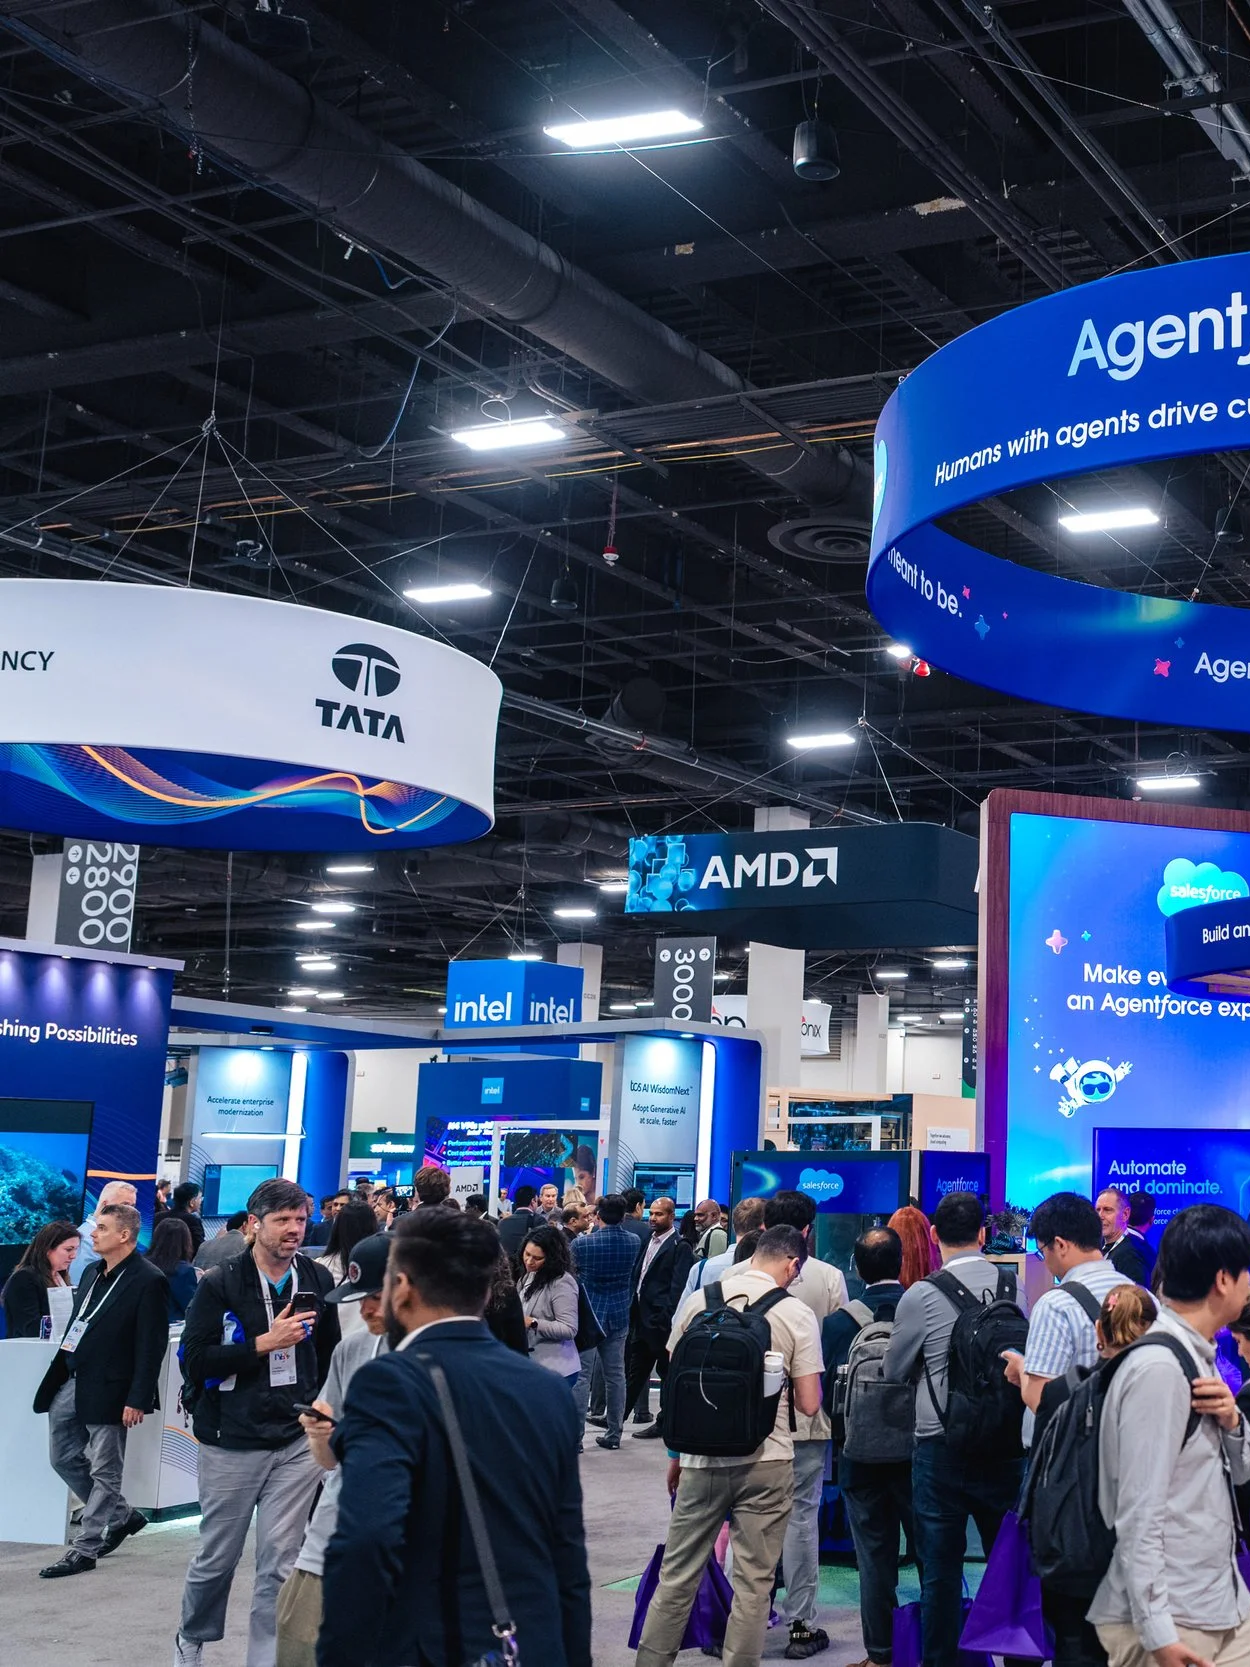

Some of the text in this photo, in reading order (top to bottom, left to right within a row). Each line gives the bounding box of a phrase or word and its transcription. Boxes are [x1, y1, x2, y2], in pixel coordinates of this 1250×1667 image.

[935, 442, 1002, 487] Humans
[1007, 428, 1049, 459] with
[1055, 409, 1140, 451] agents
[1148, 399, 1218, 431] drive
[920, 569, 933, 601] to
[937, 580, 963, 618] be.
[315, 698, 405, 744] TATA
[699, 852, 800, 889] AMD
[78, 842, 113, 945] 2800
[105, 842, 140, 944] 2900
[1170, 884, 1242, 904] salesforce
[1202, 924, 1230, 944] Build
[1233, 923, 1250, 938] an
[671, 948, 696, 1021] 3000
[1083, 962, 1142, 986] Make
[454, 991, 512, 1023] intel
[529, 993, 575, 1024] intel
[1066, 992, 1095, 1011] an
[1100, 992, 1212, 1019] Agentforce
[45, 1022, 138, 1046] Possibilities
[484, 1086, 501, 1095] intel
[207, 1095, 275, 1109] Accelerate enterprise
[217, 1107, 264, 1118] modernization
[632, 1103, 649, 1113] Adopt
[650, 1105, 680, 1115] Generative
[639, 1117, 646, 1125] at
[661, 1118, 678, 1126] faster
[1108, 1160, 1187, 1175] Automate
[456, 1184, 472, 1193] AMD
[802, 1179, 839, 1192] salesforce
[936, 1177, 979, 1195] Agentforce
[1144, 1179, 1223, 1195] dominate.
